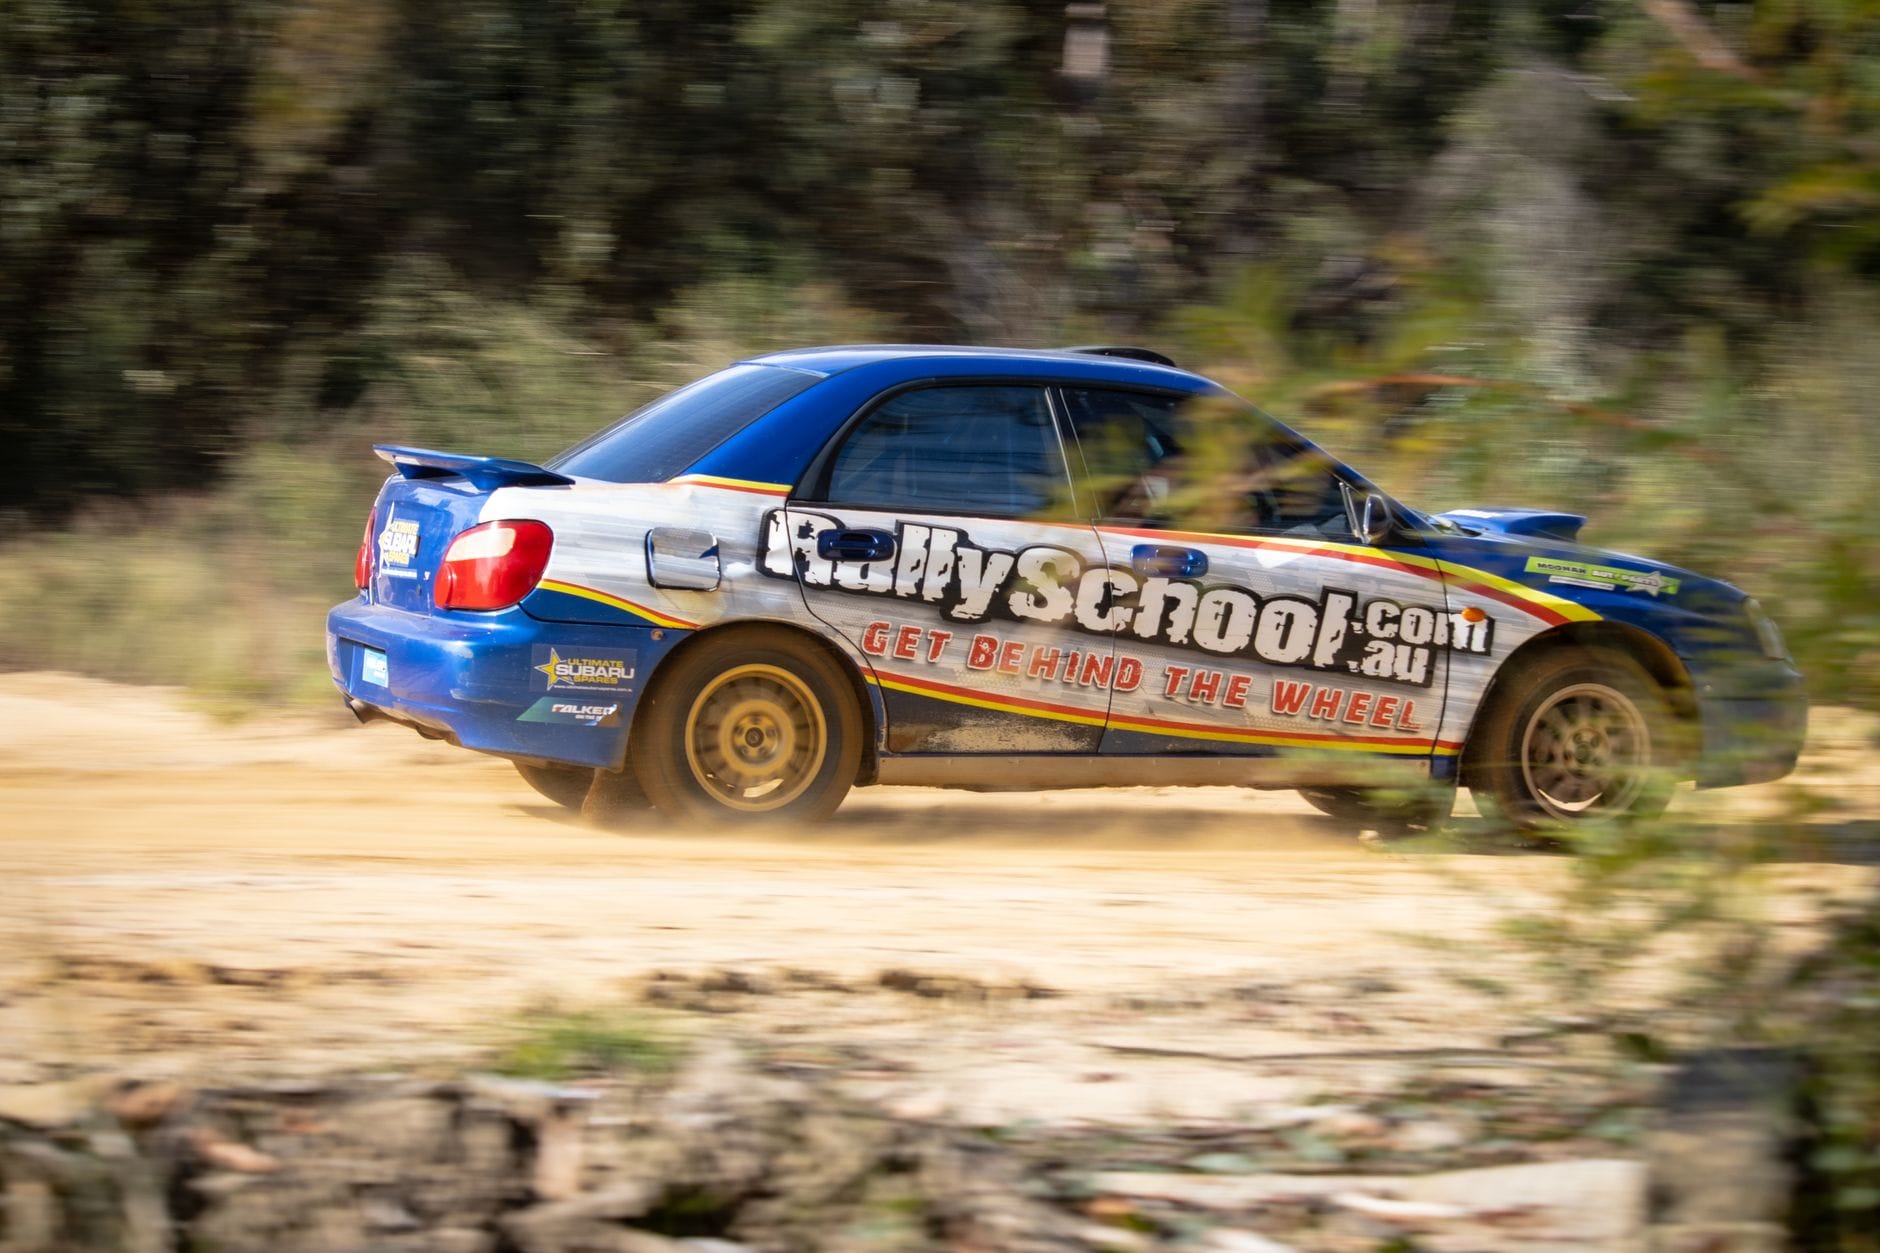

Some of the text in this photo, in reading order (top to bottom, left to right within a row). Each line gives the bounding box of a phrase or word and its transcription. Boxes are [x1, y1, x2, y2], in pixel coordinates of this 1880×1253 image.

[567, 658, 624, 668] ULTIMATE
[555, 664, 635, 679] SUBARU
[861, 621, 1423, 733] GET BEHIND THE WHEEL
[573, 675, 618, 684] SPARES
[552, 703, 617, 715] FALKEN
